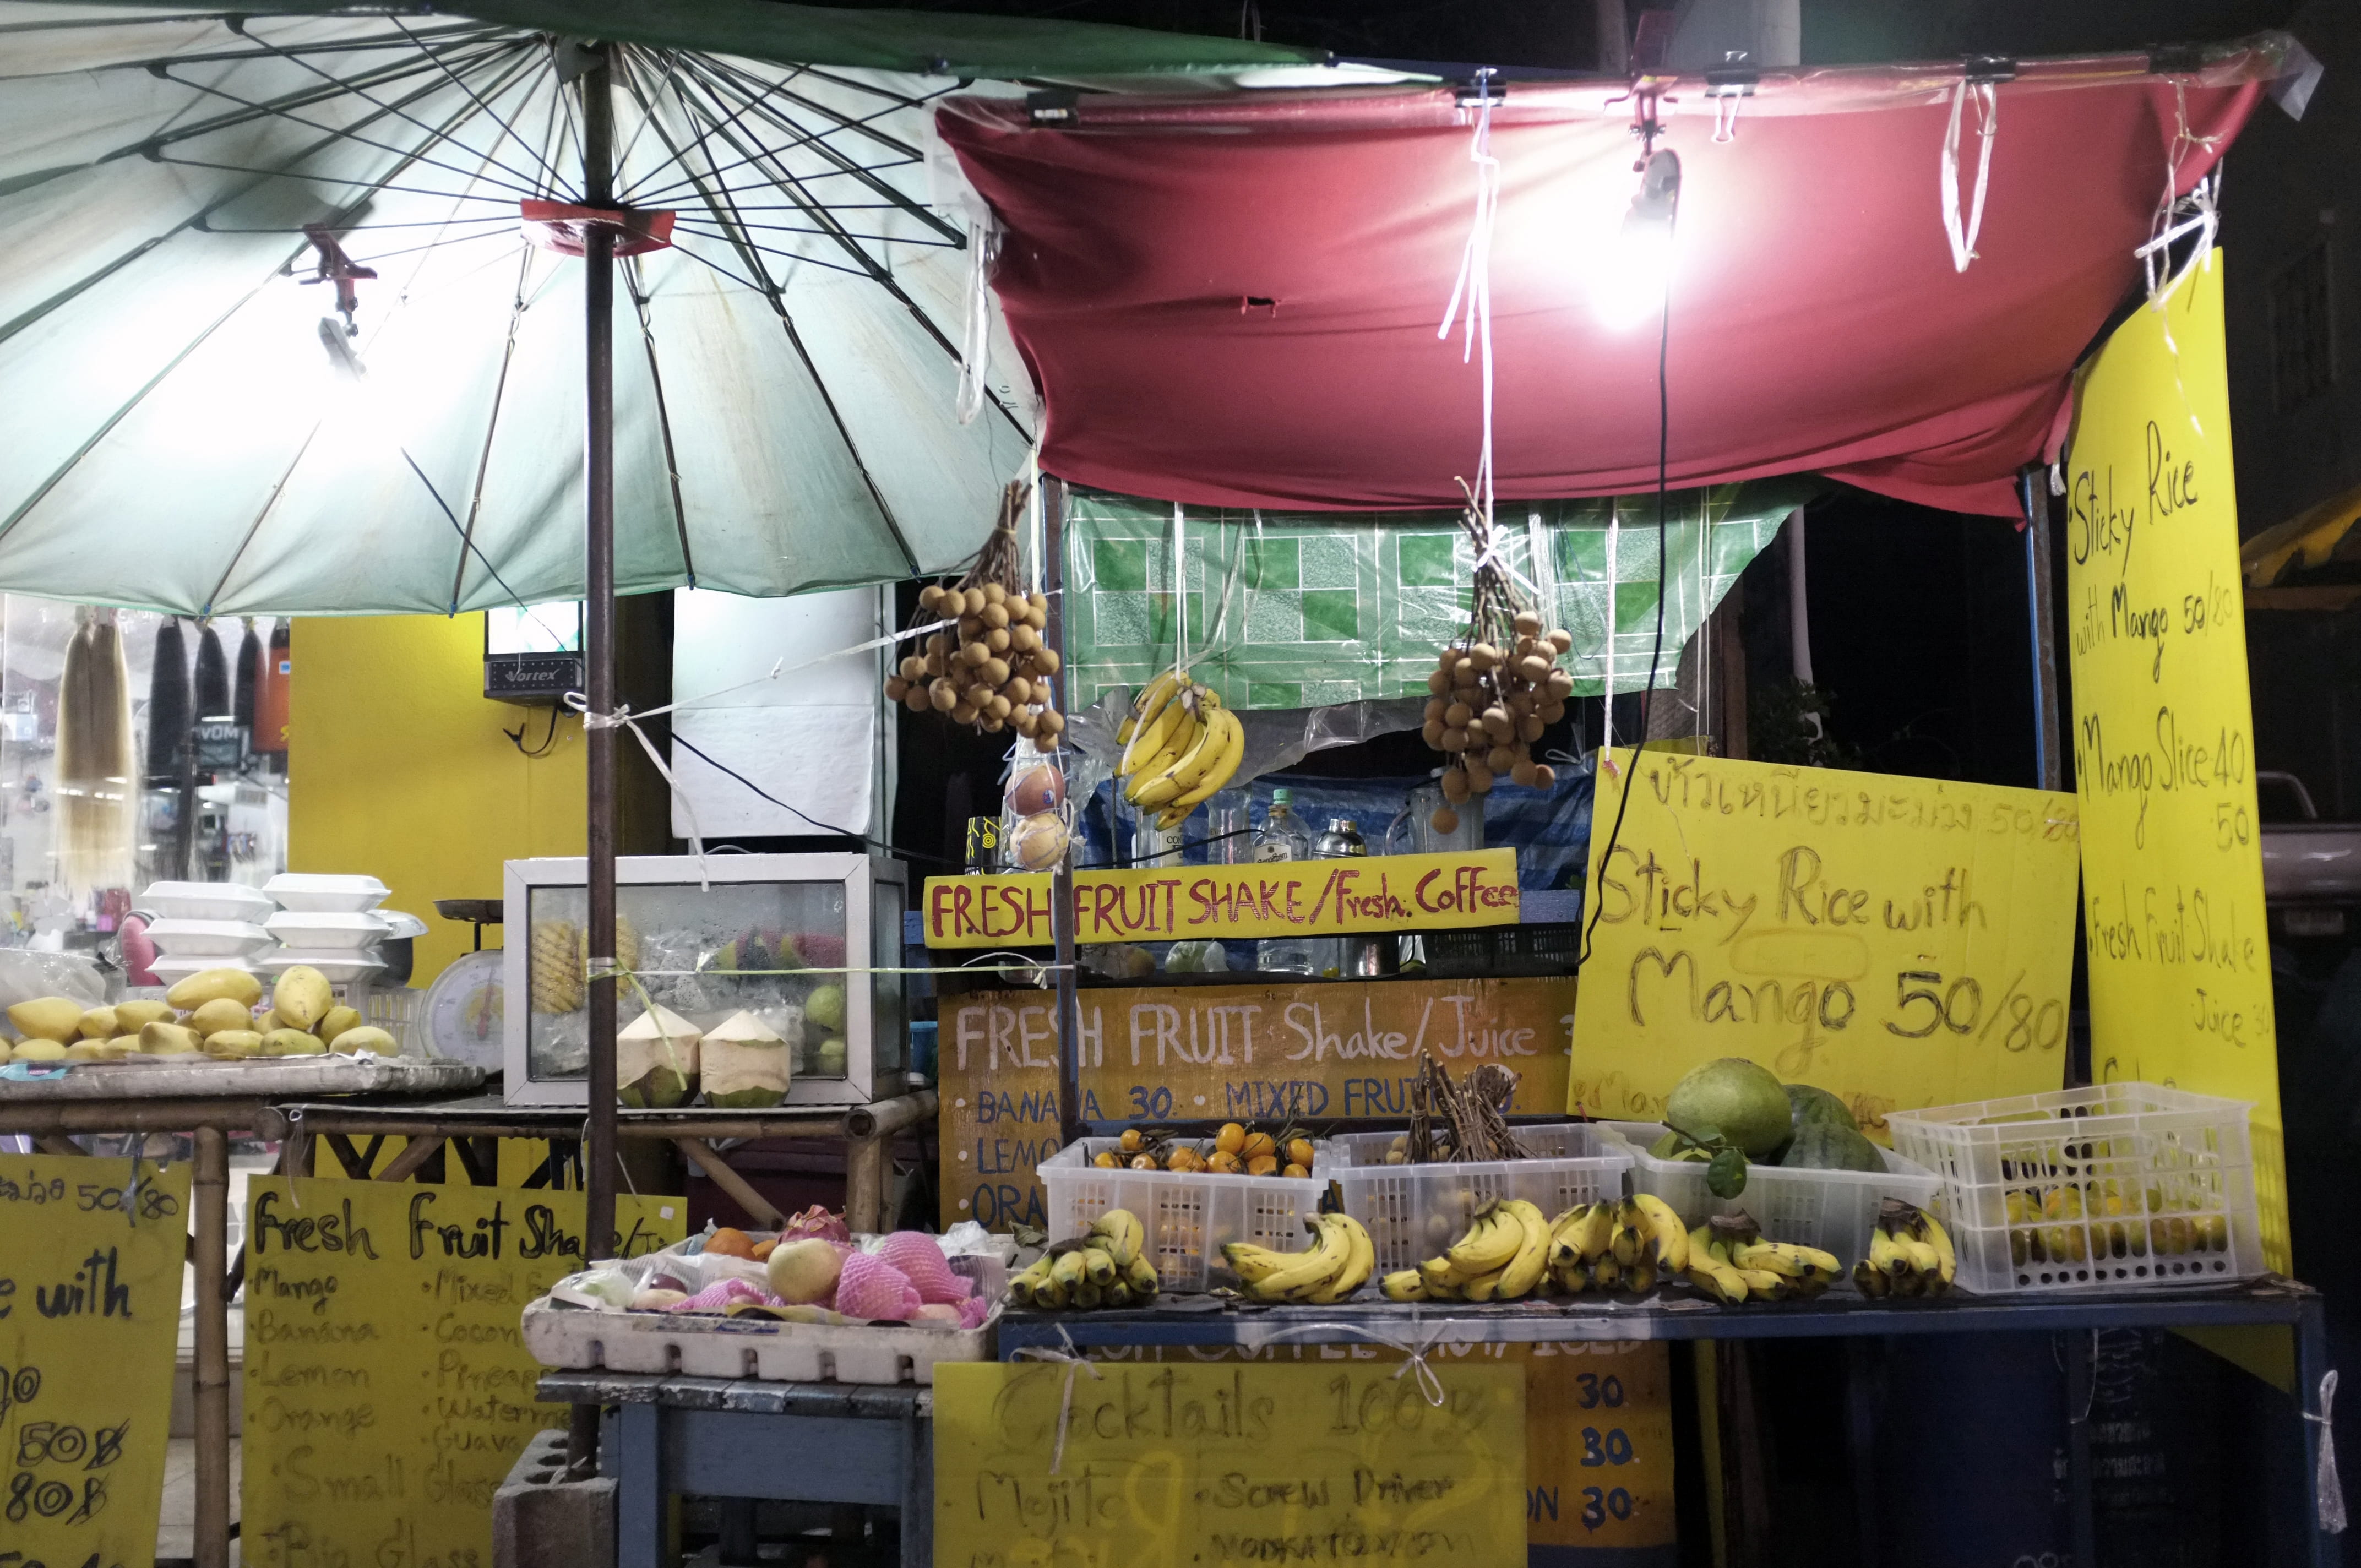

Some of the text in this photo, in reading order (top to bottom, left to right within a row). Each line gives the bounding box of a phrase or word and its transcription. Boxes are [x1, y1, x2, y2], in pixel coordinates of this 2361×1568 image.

[2074, 420, 2199, 578] Sticky Rice
[2076, 584, 2106, 657] with
[2111, 582, 2169, 683] Mango
[504, 668, 561, 682] Vortex
[2082, 711, 2153, 851] Mango
[2156, 706, 2209, 792] Slice
[932, 885, 1053, 938] FRESH
[1074, 879, 1182, 936] FRUIT
[1415, 867, 1519, 913] Coffee
[1596, 843, 1988, 946] Sticky Rice with
[2093, 880, 2142, 961] Fresh
[1129, 1003, 1263, 1066] FRUIT
[1629, 946, 2065, 1077] Mango 50/80
[976, 1088, 1105, 1124] BANAA
[1225, 1077, 1328, 1119] MIXED
[253, 1190, 380, 1262] Fresh
[408, 1190, 510, 1261] Fruit
[36, 1245, 134, 1319] with
[253, 1267, 338, 1315] Mango
[257, 1308, 380, 1345] Banana
[258, 1349, 371, 1388] Lemon
[260, 1396, 377, 1440] Orange
[975, 1463, 1130, 1539] Mojito
